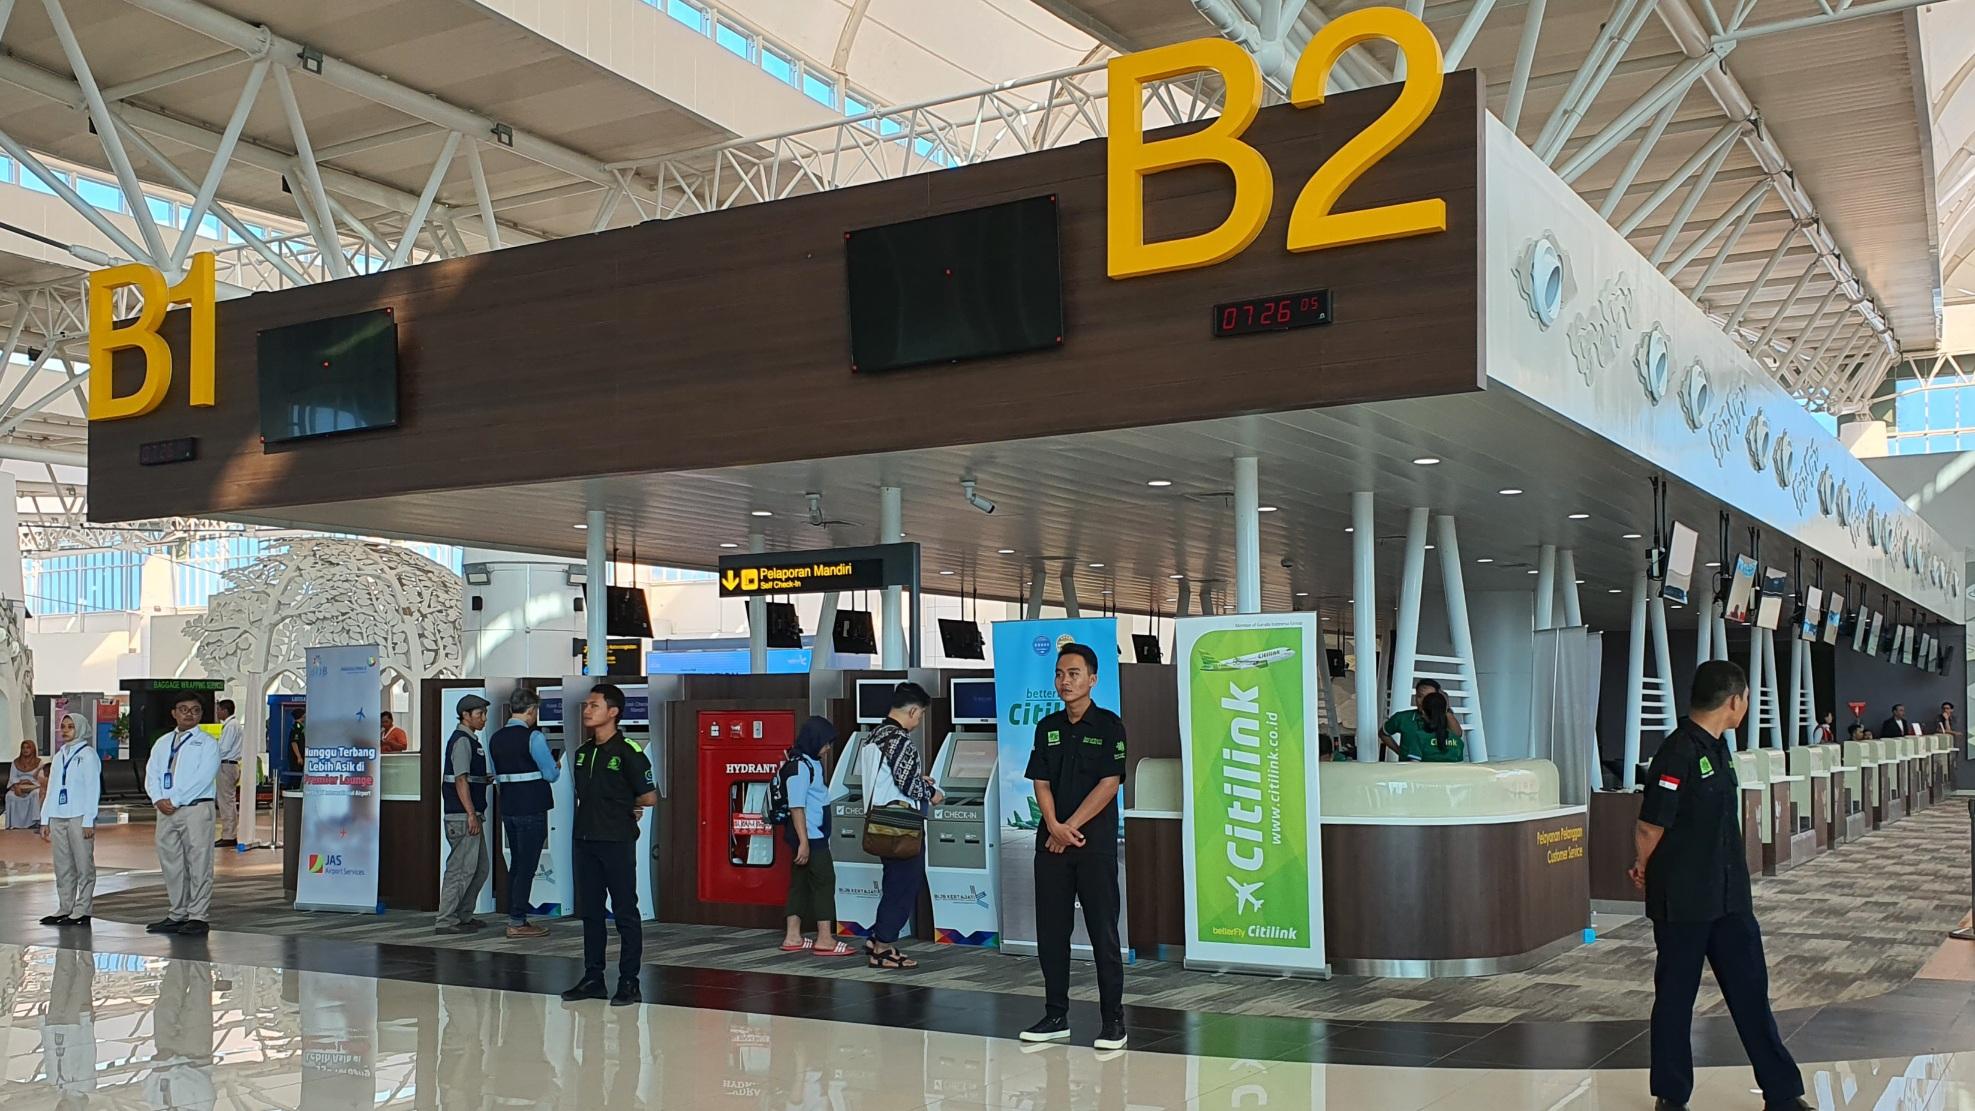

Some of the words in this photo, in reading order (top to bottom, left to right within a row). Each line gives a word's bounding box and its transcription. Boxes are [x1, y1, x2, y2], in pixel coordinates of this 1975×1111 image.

[1106, 6, 1447, 280] B2
[1300, 296, 1319, 312] 05
[88, 251, 216, 422] B1
[760, 567, 811, 581] Pelaporan
[813, 563, 852, 577] Mandiri
[760, 581, 772, 590] Self
[773, 580, 802, 589] Check-In
[153, 681, 180, 689] BAGGAGE
[181, 681, 205, 689] WRAPPING
[338, 746, 376, 760] Terbang
[309, 761, 334, 772] Lebih
[336, 761, 356, 772] Asik
[356, 761, 365, 772] di
[725, 763, 778, 774] HYDRANT
[304, 775, 339, 786] Premier
[340, 775, 373, 788] Lounge
[1221, 681, 1264, 871] Citilink
[1266, 712, 1281, 845] www.citilink.co.id
[944, 811, 977, 819] CHECK-IN
[1537, 831, 1560, 846] Pelayanan
[325, 854, 342, 866] JAS
[1548, 850, 1568, 864] Customer
[1568, 845, 1583, 859] Service
[1247, 925, 1297, 940] Citilink
